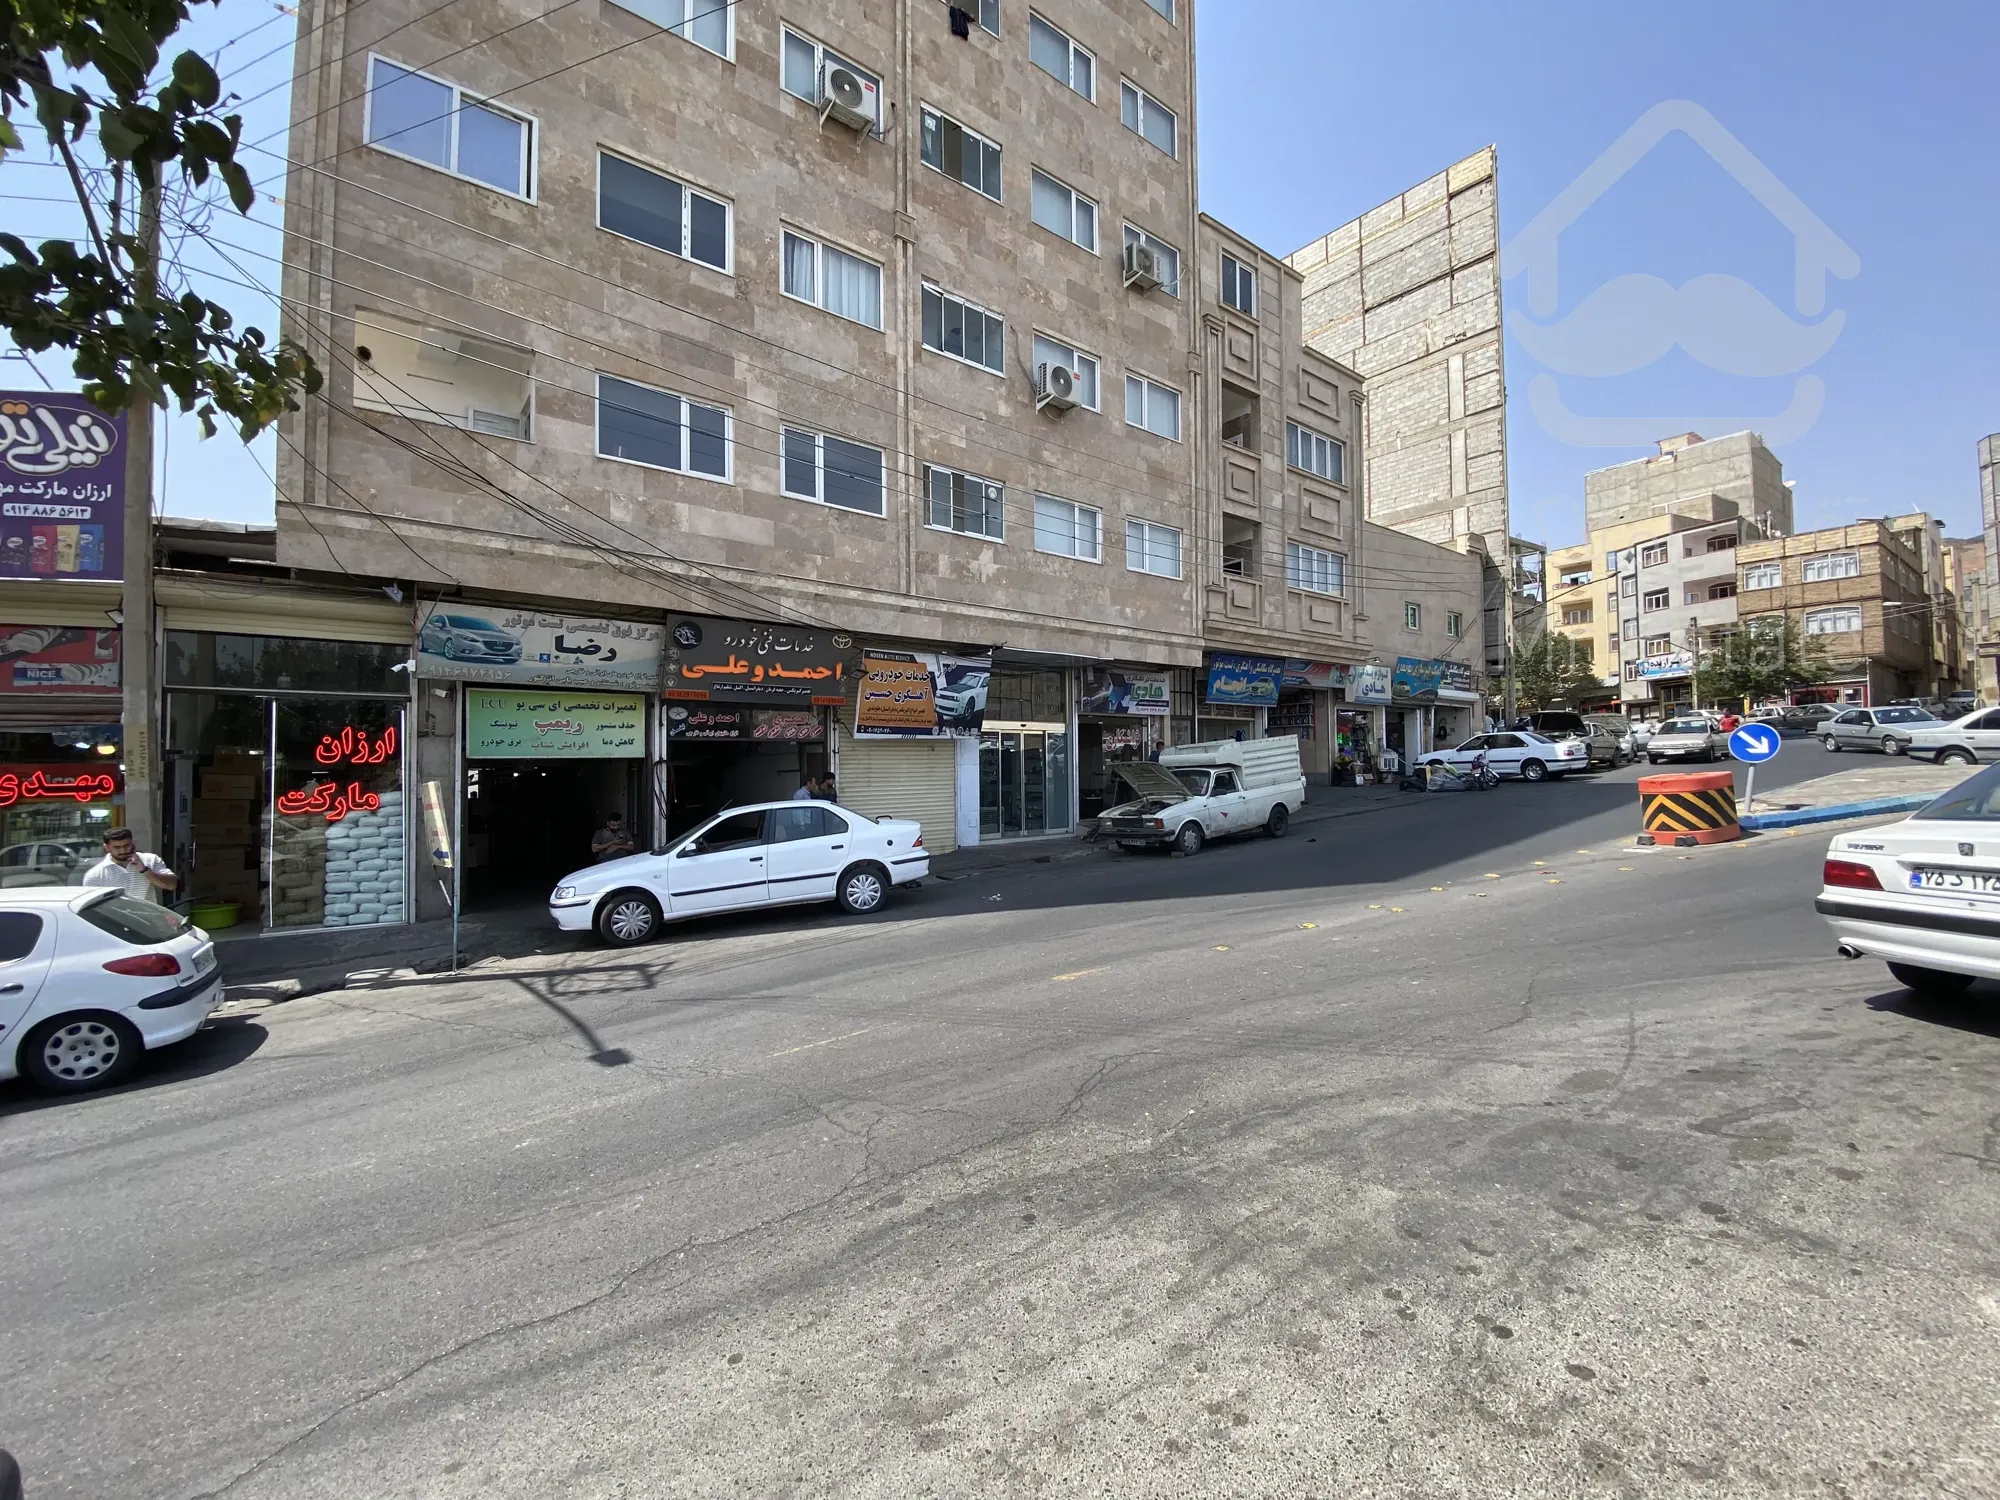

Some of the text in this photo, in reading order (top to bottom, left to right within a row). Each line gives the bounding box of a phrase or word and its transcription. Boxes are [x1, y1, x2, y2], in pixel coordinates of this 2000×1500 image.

[7, 408, 109, 473] نیلی
[19, 480, 68, 499] مارکت
[72, 483, 112, 501] ارزان
[501, 611, 535, 629] موتور
[538, 618, 564, 629] تست
[566, 620, 610, 633] تخصصی
[554, 634, 617, 662] رضا
[723, 627, 814, 655] خدمات فنی خودرو
[27, 670, 56, 678] NICE
[681, 653, 843, 682] احمد و علی
[905, 667, 930, 682] خدمات
[864, 687, 929, 704] آهنگری حسین
[1130, 682, 1164, 701] هادی
[1362, 680, 1386, 697] هادی
[480, 698, 507, 709] ECU
[515, 700, 637, 714] تعمیرات تخصصی ای سی یو
[534, 718, 583, 734] ریمپ
[688, 711, 740, 725] احمد و علی
[595, 722, 636, 731] حذف سنسور
[315, 725, 395, 763] ارزان
[480, 738, 505, 746] خودرو
[530, 741, 589, 751] افزایش شتاب
[614, 738, 635, 747] کاهش
[0, 770, 115, 807] مهدی
[277, 782, 380, 821] مارکت
[1924, 871, 1945, 887] ۷۵
